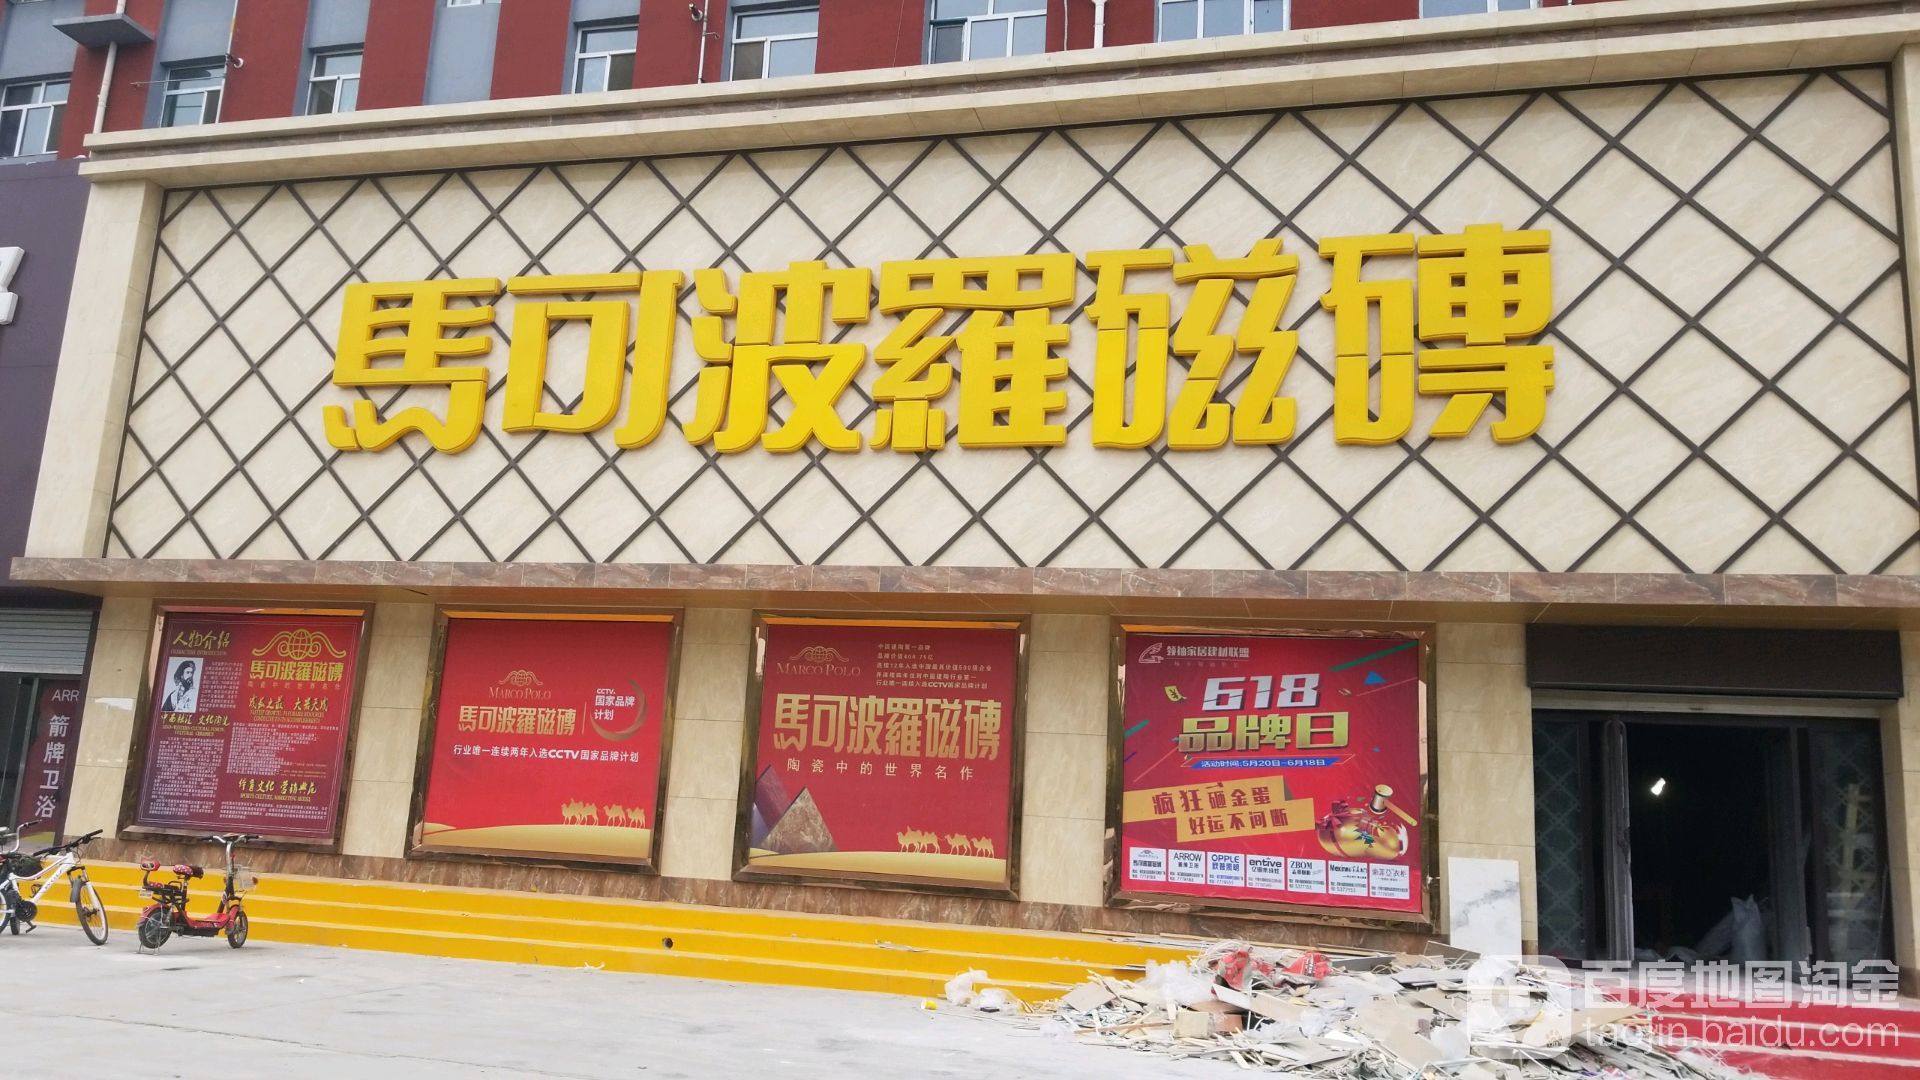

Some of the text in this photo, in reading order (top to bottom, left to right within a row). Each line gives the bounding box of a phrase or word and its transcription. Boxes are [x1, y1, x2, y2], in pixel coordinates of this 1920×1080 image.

[323, 223, 1553, 455] 馬可波羅磁磚
[776, 662, 861, 677] MARCO POLO
[488, 686, 551, 700] MARCO POLO
[595, 695, 635, 707] 国家品牌
[1202, 673, 1320, 711] 618
[458, 705, 577, 737] 馬可波羅磁磚
[594, 709, 614, 720] 计划
[773, 692, 1002, 761] 馬可波羅磁磚
[1178, 711, 1349, 752] 品牌日
[453, 744, 640, 763] 行业唯一连续两年入选CCTV国家品牌计划
[35, 714, 70, 818] 箭牌卫浴
[787, 758, 973, 781] 陶瓷中的世界名作
[1152, 786, 1271, 815] 疯狂砸金蛋
[1189, 808, 1289, 835] 好运不间断
[1174, 852, 1202, 862] ARROW
[1211, 853, 1240, 863] OPPLE
[1249, 857, 1282, 867] entive
[1290, 861, 1312, 870] ZBOM
